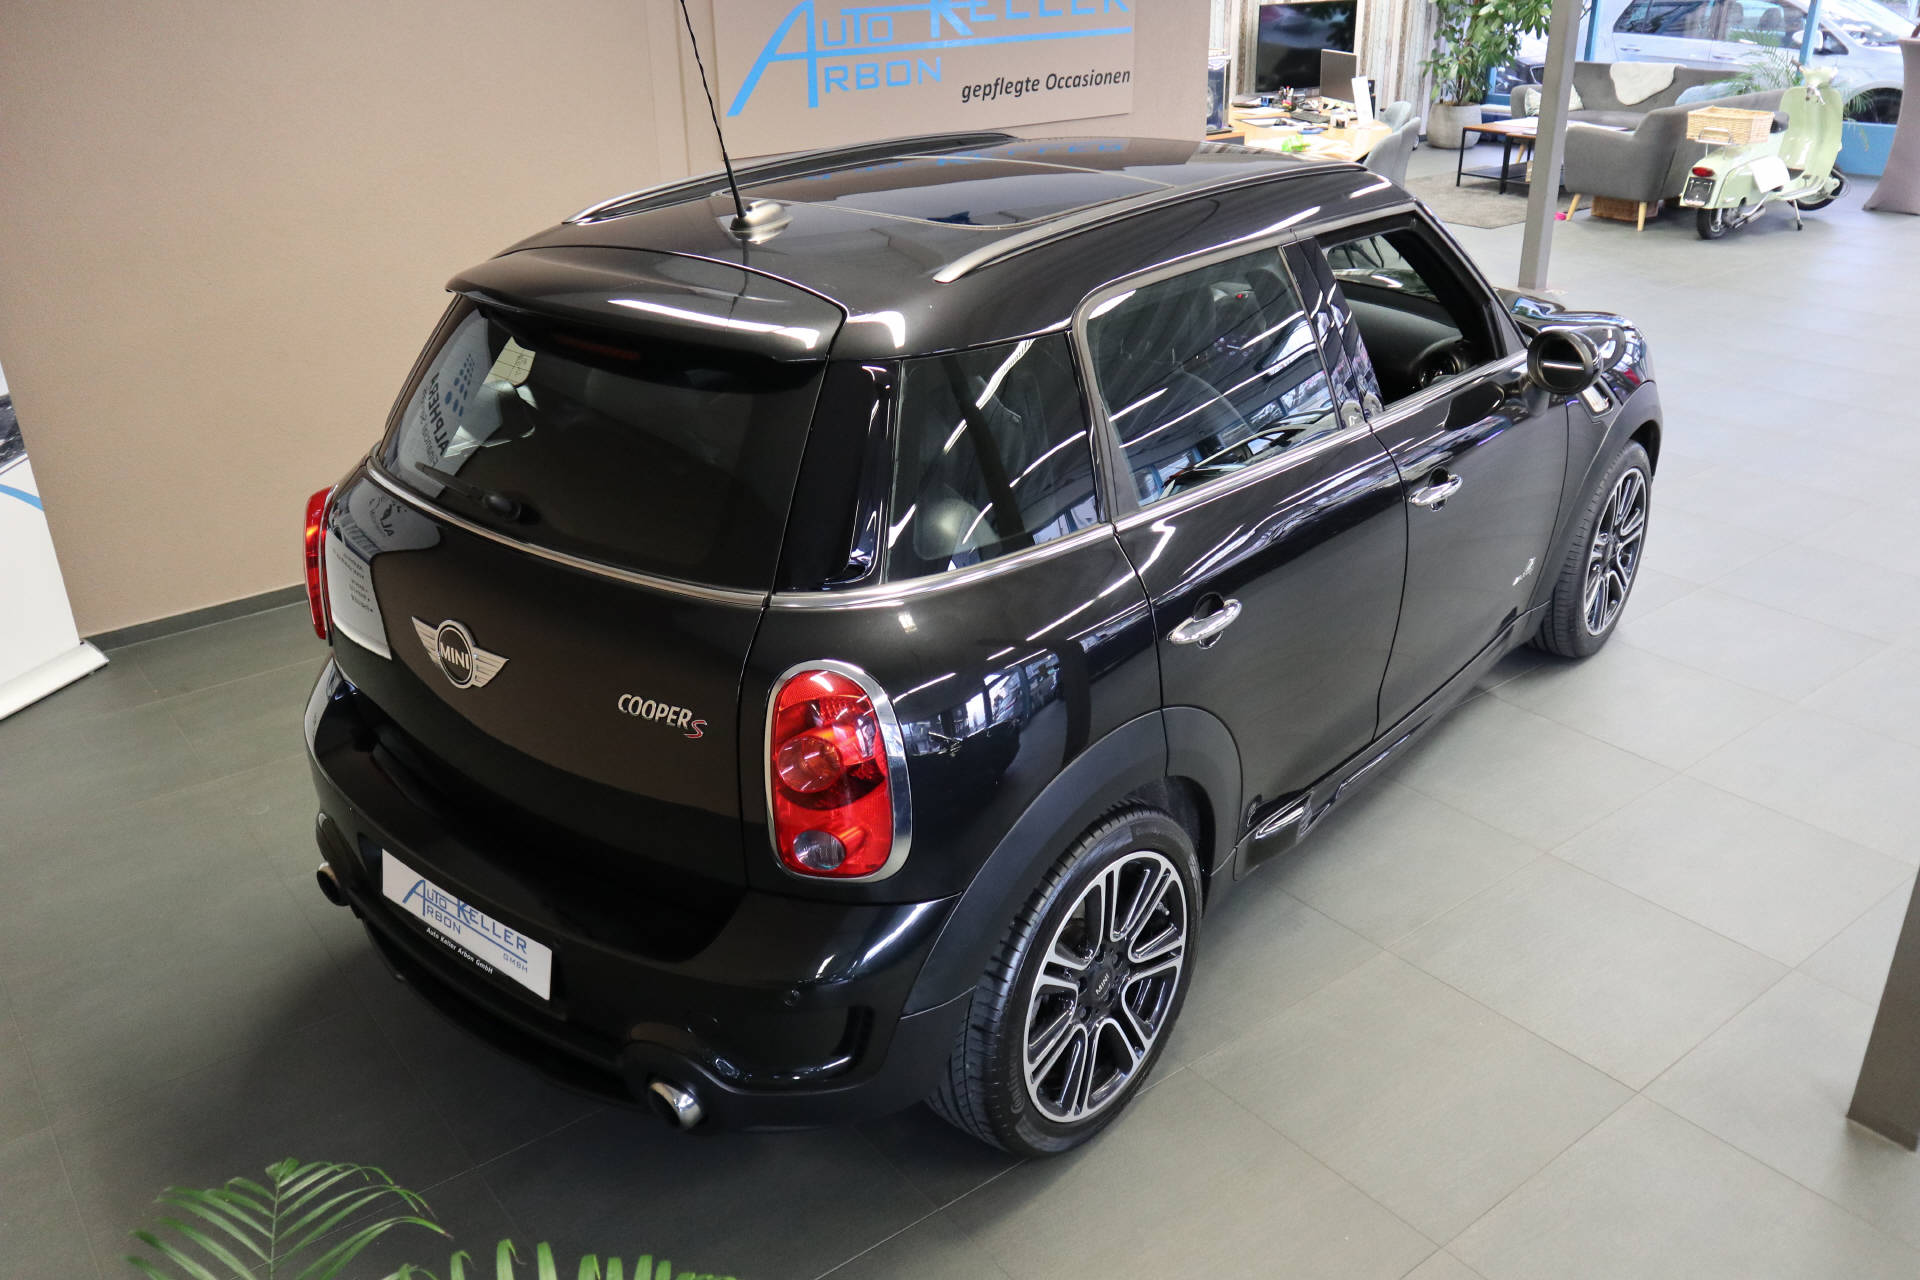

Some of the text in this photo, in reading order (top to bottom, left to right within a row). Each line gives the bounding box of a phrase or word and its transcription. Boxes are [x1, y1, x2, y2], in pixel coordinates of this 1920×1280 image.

[961, 69, 1131, 102] gepflegte Occasionen
[439, 641, 471, 670] MINI
[617, 693, 708, 739] COOPER S
[457, 899, 527, 955] KELLER
[426, 927, 440, 939] Auto
[457, 947, 475, 962] Arbon
[475, 959, 493, 975] GmbH
[1095, 972, 1110, 995] MINI
